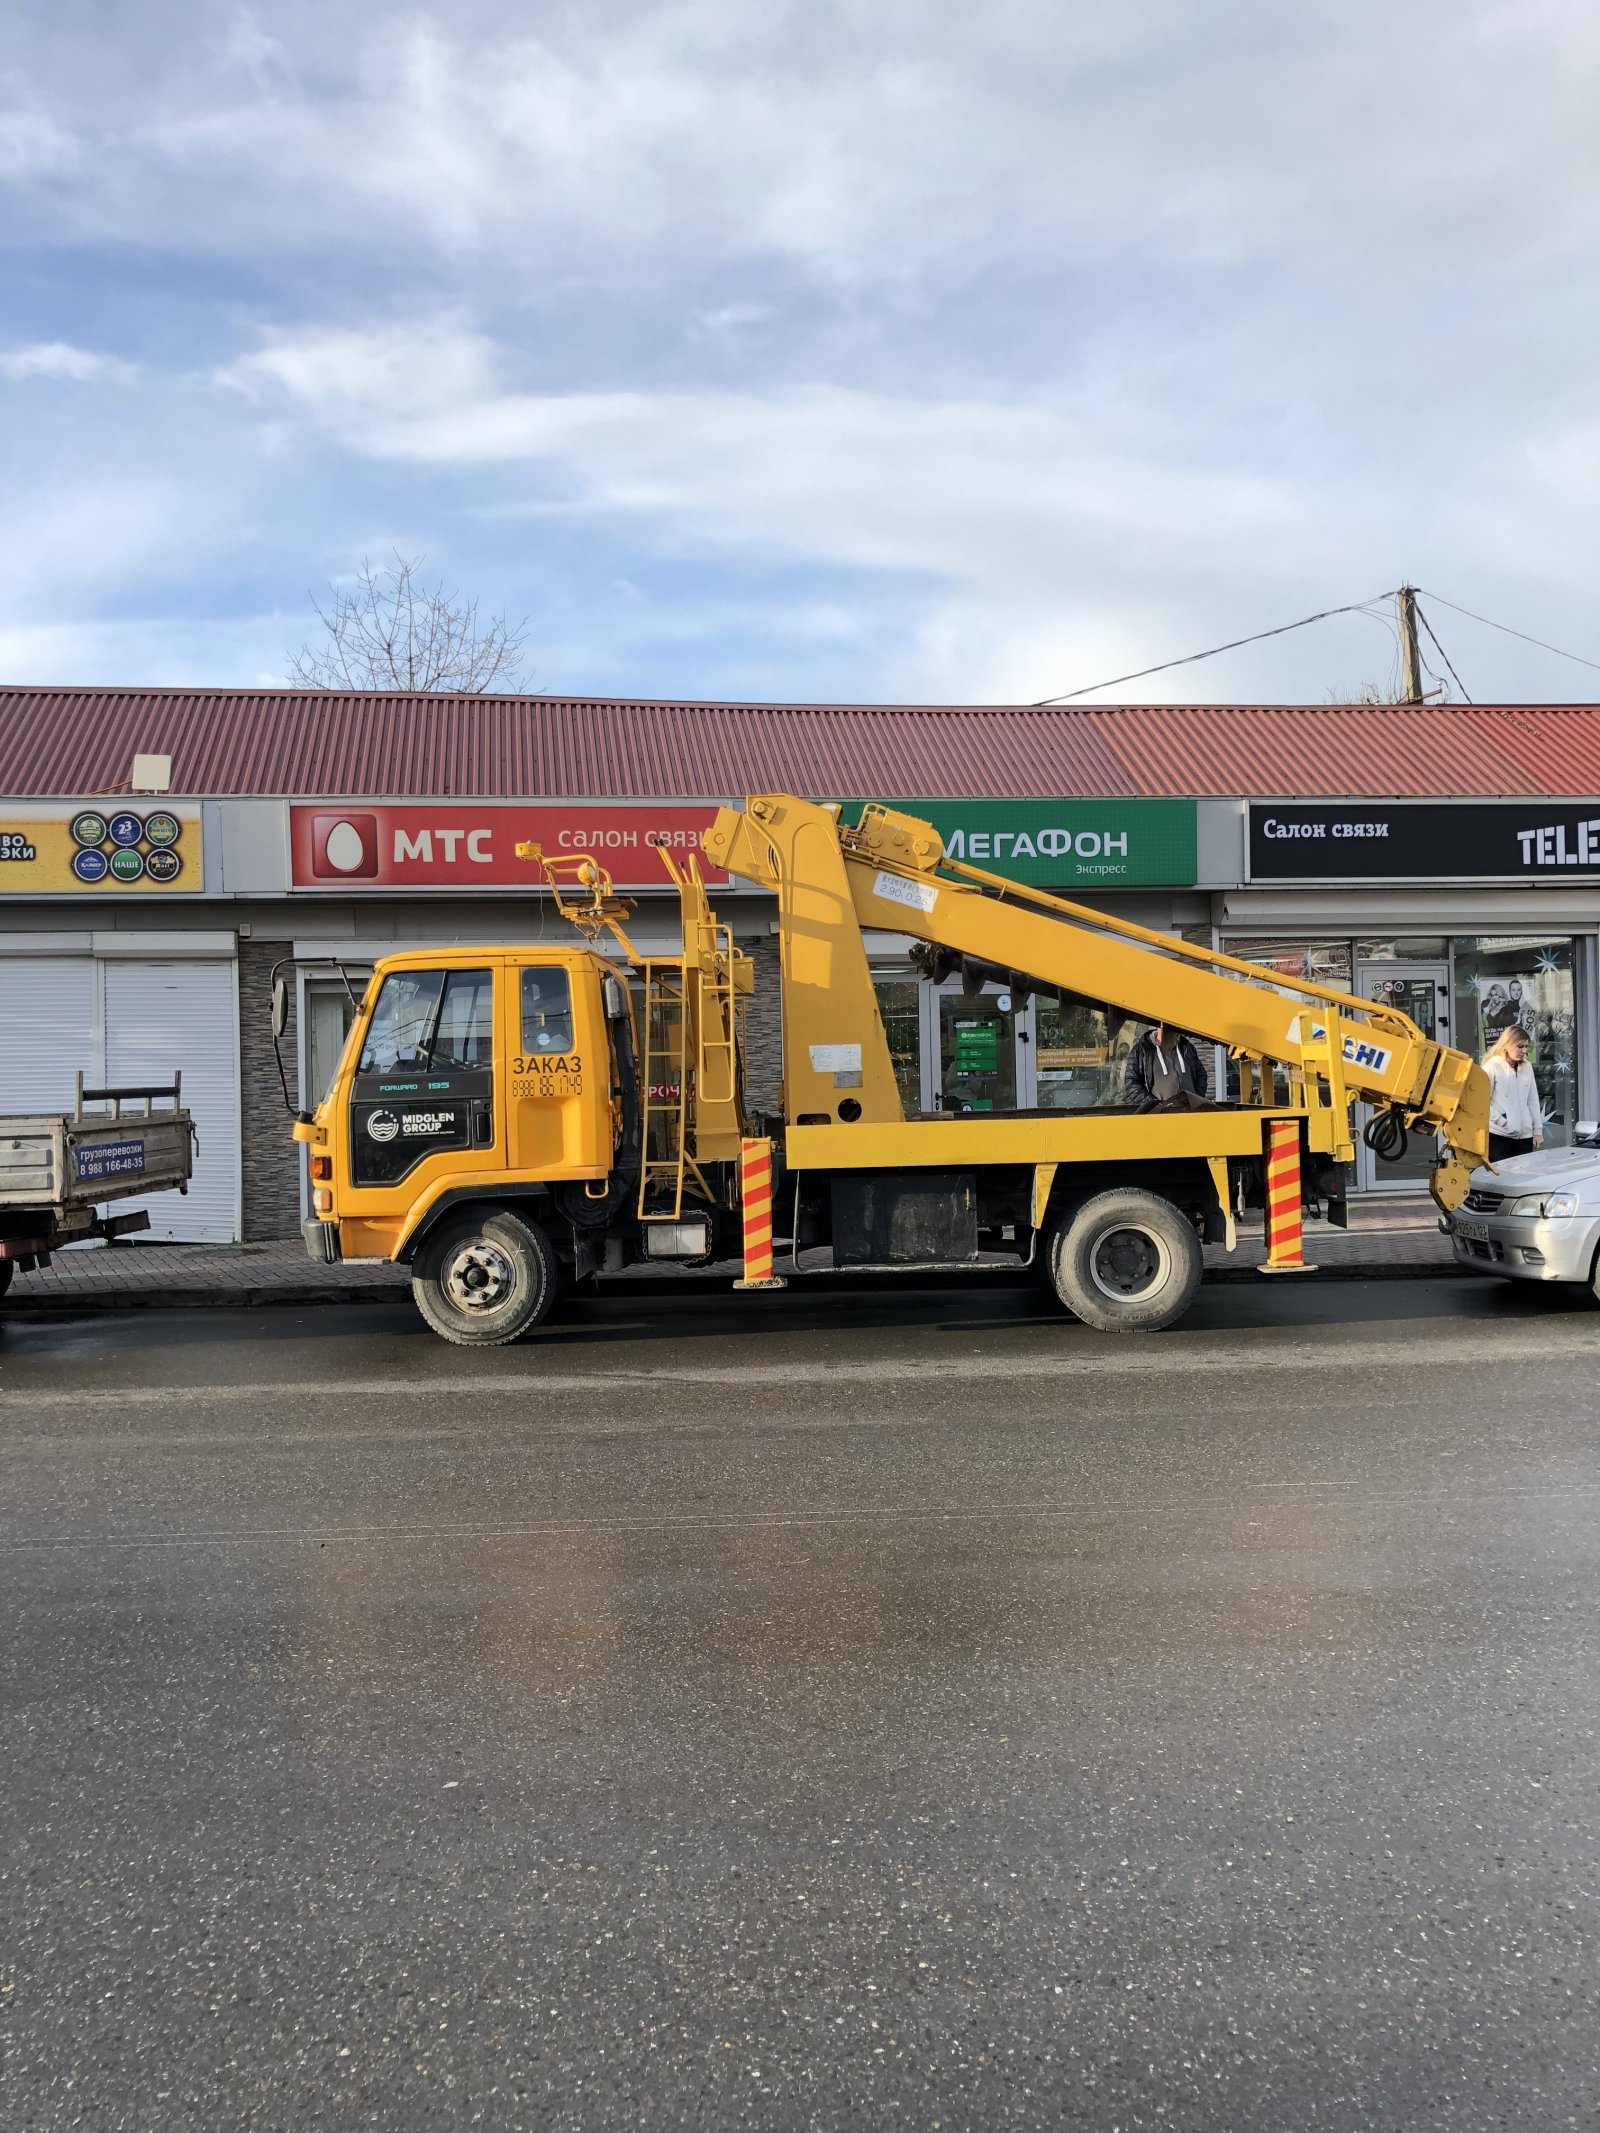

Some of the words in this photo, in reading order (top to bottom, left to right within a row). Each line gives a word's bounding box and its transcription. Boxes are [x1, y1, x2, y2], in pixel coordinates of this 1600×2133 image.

[1263, 819, 1326, 839] Салон
[1332, 822, 1389, 838] связи
[394, 829, 493, 863] МТС
[558, 830, 637, 848] салон
[114, 861, 140, 869] НАШЕ
[513, 1056, 582, 1074] ЗАКАЗ
[379, 1083, 418, 1091] FORWARD
[402, 1112, 455, 1124] MIDGLEN
[402, 1122, 442, 1133] GROUP
[80, 1145, 142, 1162] грузоперевозки
[80, 1165, 86, 1175] 8
